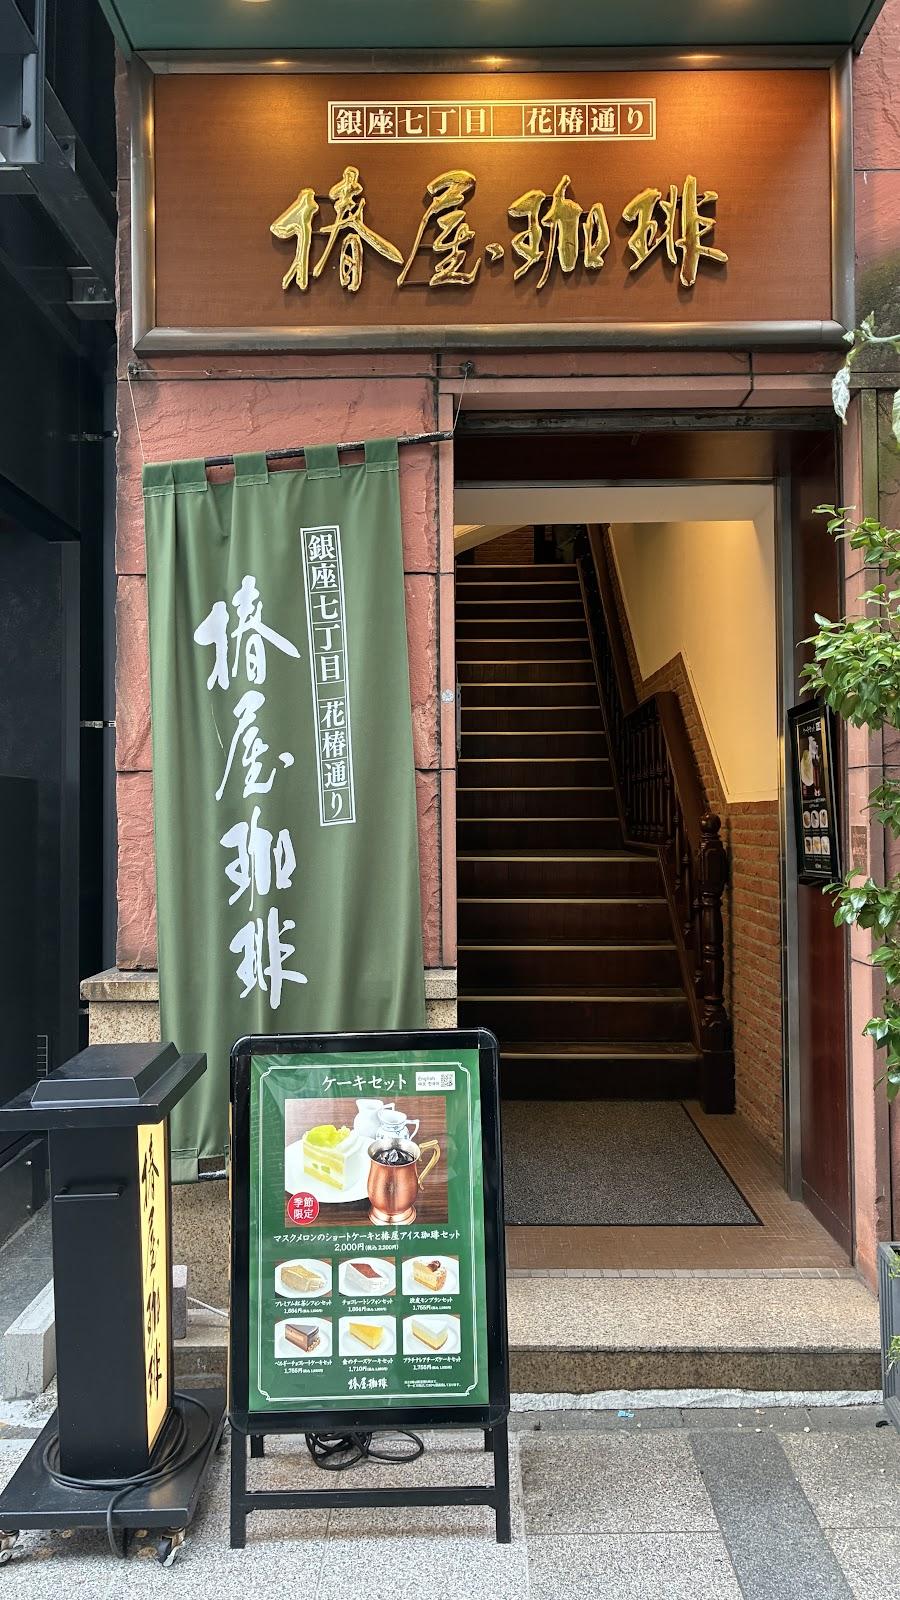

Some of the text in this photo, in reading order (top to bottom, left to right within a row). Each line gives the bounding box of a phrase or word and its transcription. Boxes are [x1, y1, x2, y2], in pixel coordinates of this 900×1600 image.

[336, 107, 644, 134] 銀座七丁目 花椿通り
[307, 533, 348, 819] 銀座七丁目 花椿通り
[193, 574, 308, 1010] 椿屋珈琲
[322, 1073, 407, 1092] ケーキセット
[293, 1197, 314, 1208] 季節
[293, 1209, 314, 1220] 限定
[273, 1230, 461, 1243] マスクメロンのショートケーキと椿屋アイス珈琲セット
